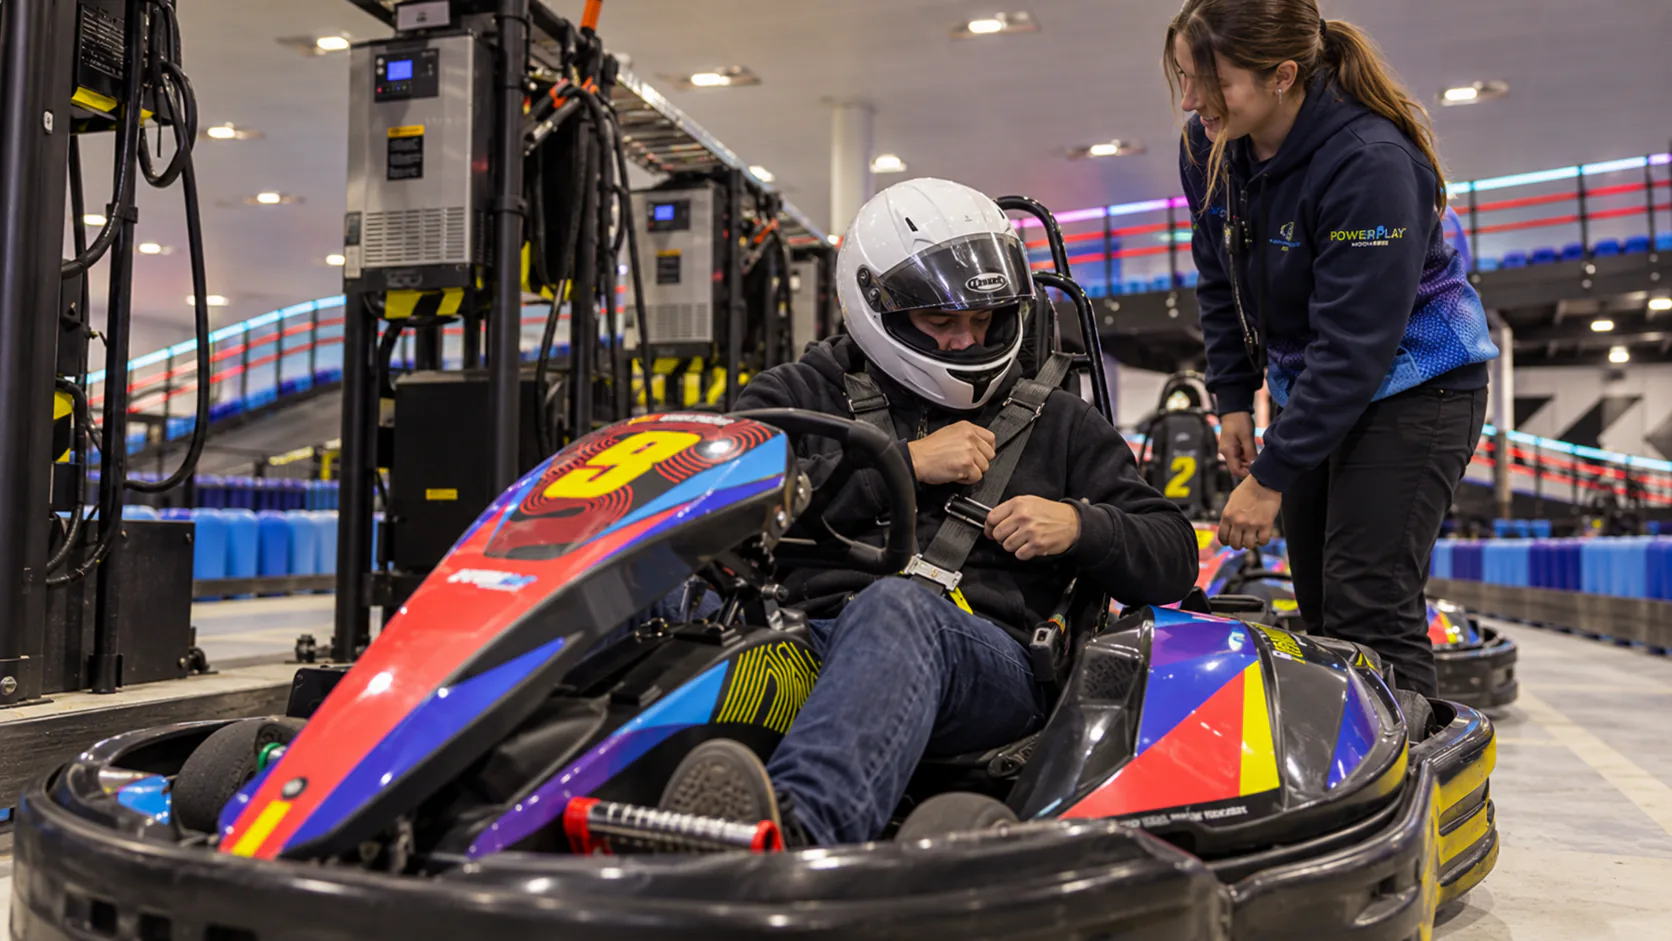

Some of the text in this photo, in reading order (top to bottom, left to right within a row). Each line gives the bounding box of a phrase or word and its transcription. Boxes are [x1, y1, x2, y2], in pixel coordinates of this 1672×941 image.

[1330, 225, 1406, 241] POWERPLAY
[543, 431, 701, 498] 9
[1164, 456, 1197, 498] 2
